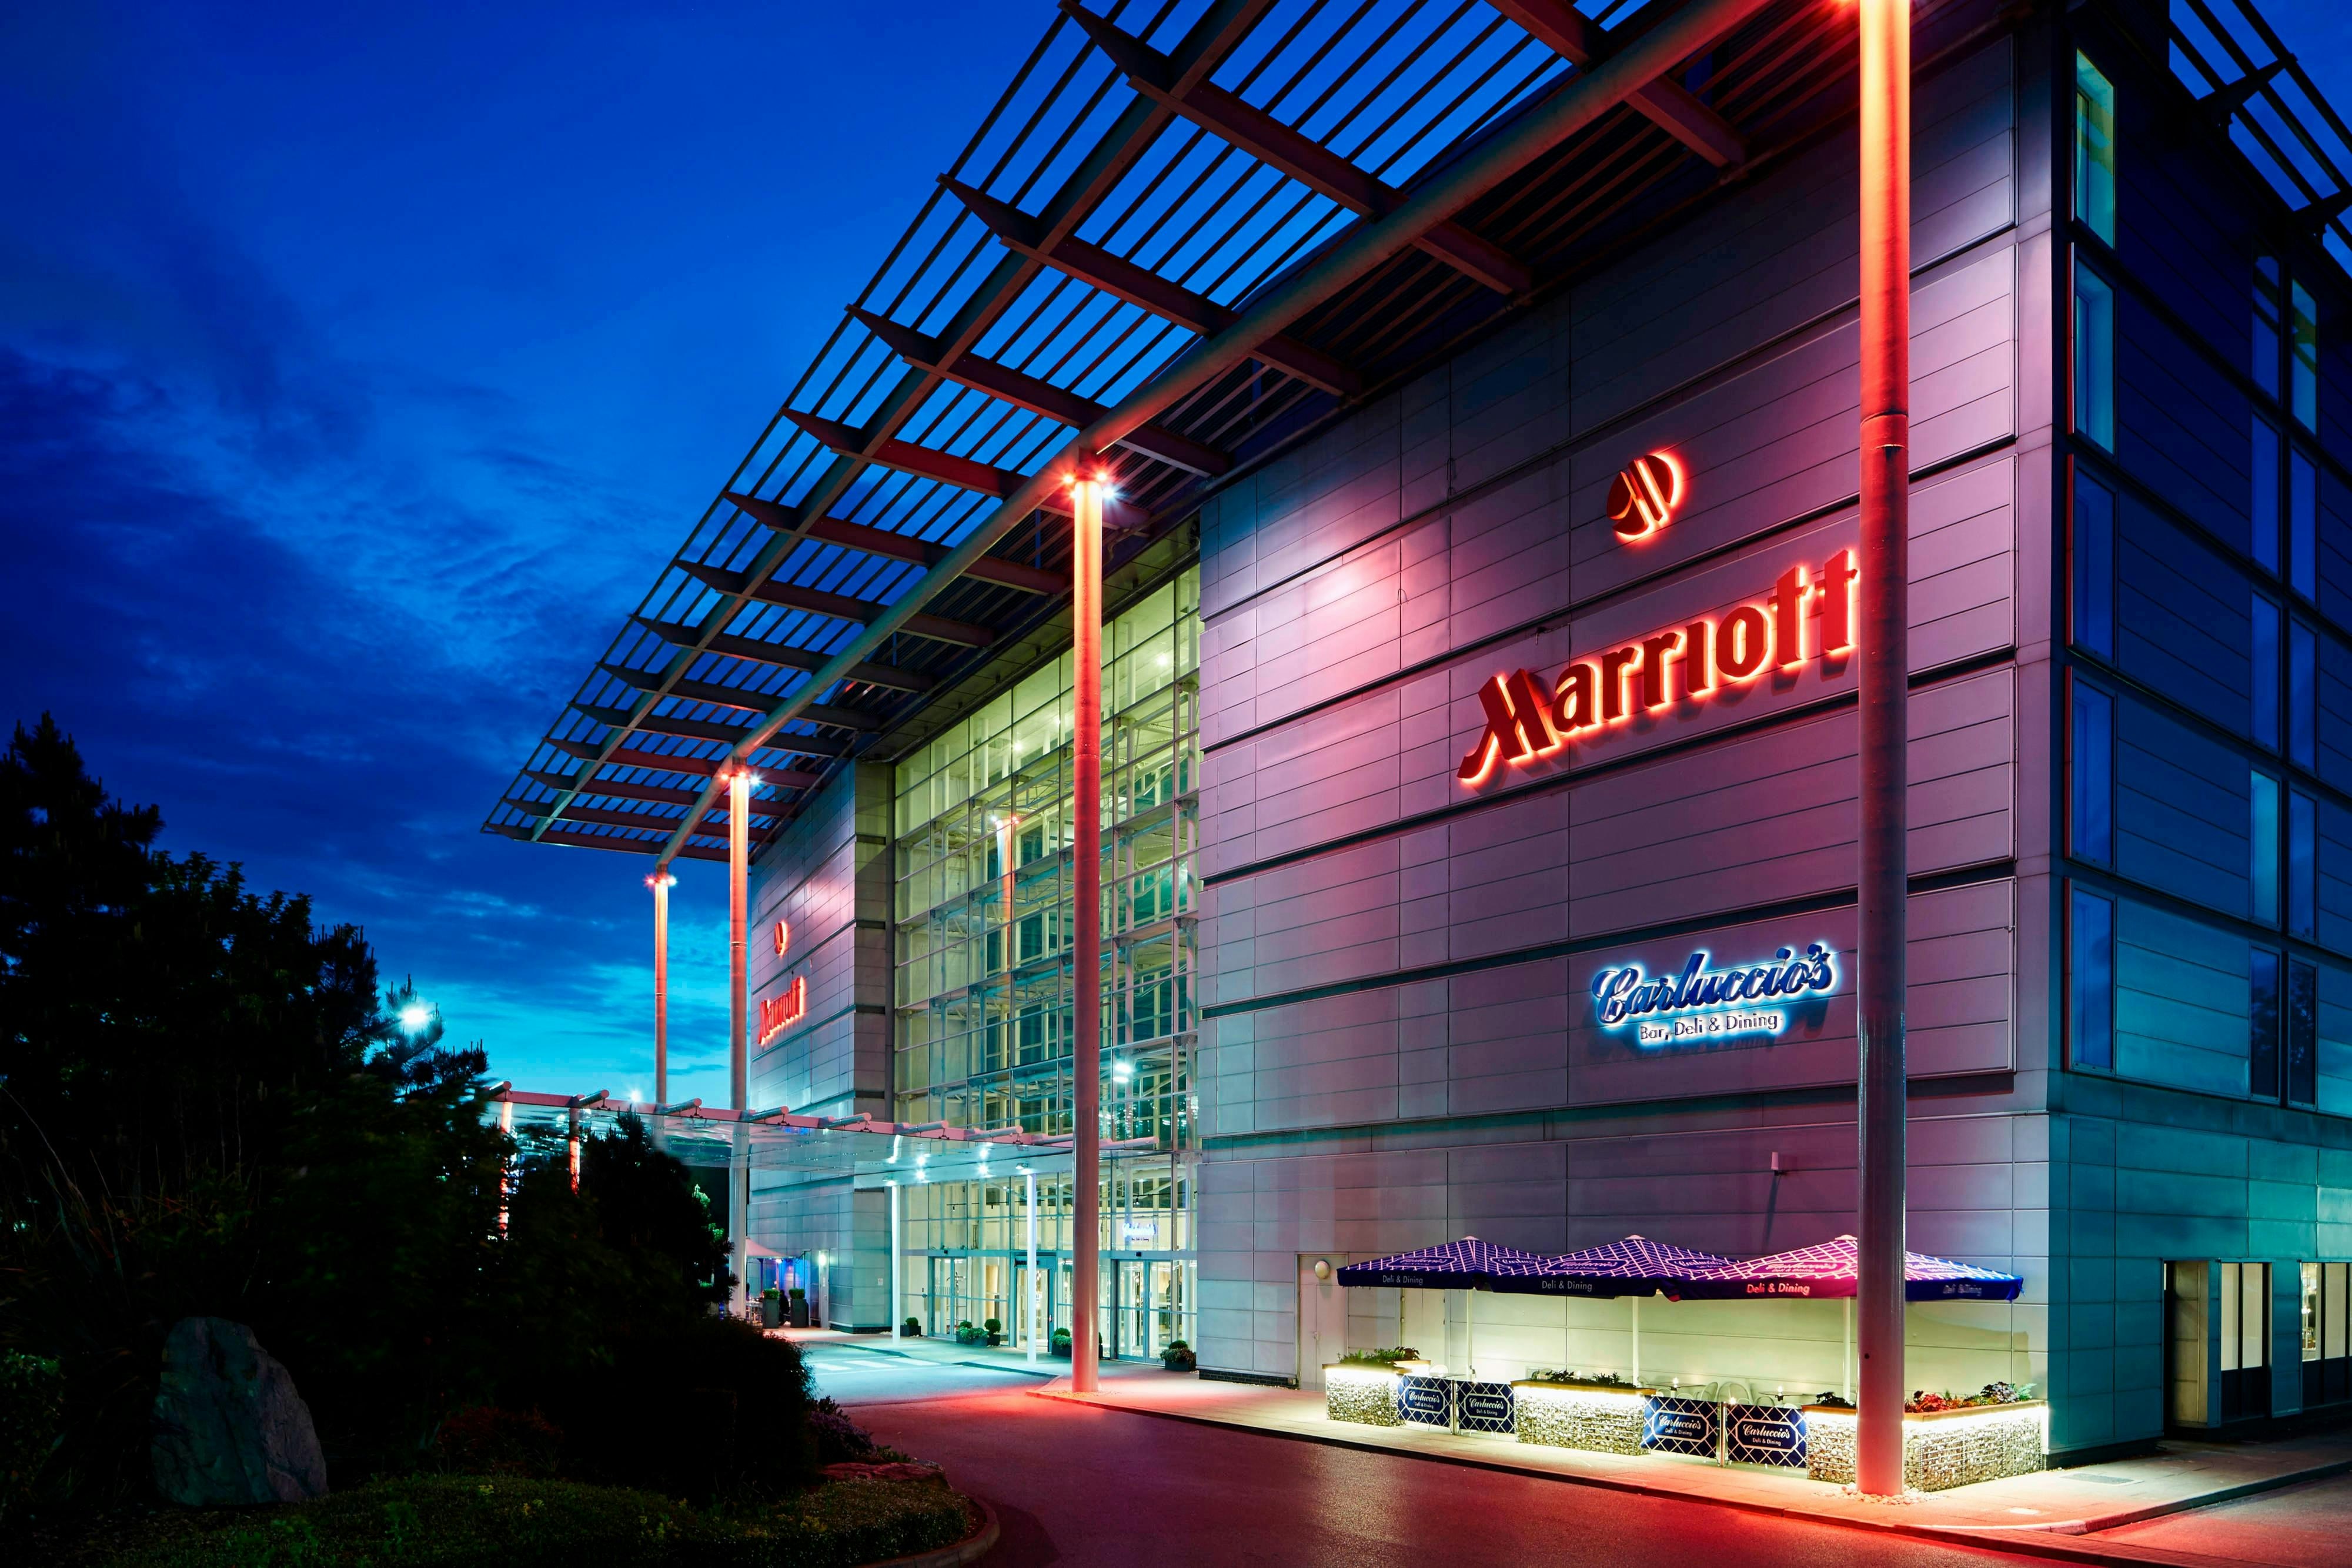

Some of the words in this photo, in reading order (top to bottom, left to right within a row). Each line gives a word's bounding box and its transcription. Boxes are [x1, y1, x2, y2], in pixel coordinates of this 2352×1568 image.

[1456, 549, 1859, 780] Marriott
[1592, 944, 1832, 1024] Carluccio's
[1641, 1026, 1669, 1040] Bar,
[1675, 1018, 1703, 1036] Deli
[1709, 1017, 1720, 1032] &
[1726, 1013, 1778, 1030] Dining
[1382, 1275, 1394, 1283] Deli
[1396, 1275, 1401, 1283] &
[1403, 1275, 1423, 1285] Dining
[1542, 1280, 1556, 1289] Deli
[1559, 1281, 1564, 1289] &
[1567, 1281, 1592, 1292] Dining
[1747, 1283, 1765, 1293] Deli
[1768, 1283, 1776, 1293] &
[1778, 1283, 1810, 1296] Dining
[1408, 1390, 1440, 1403] Carluccio's
[1469, 1398, 1504, 1409] Carluccio's
[1659, 1415, 1701, 1430] Carluccio's
[1743, 1424, 1790, 1439] Carluccio's
